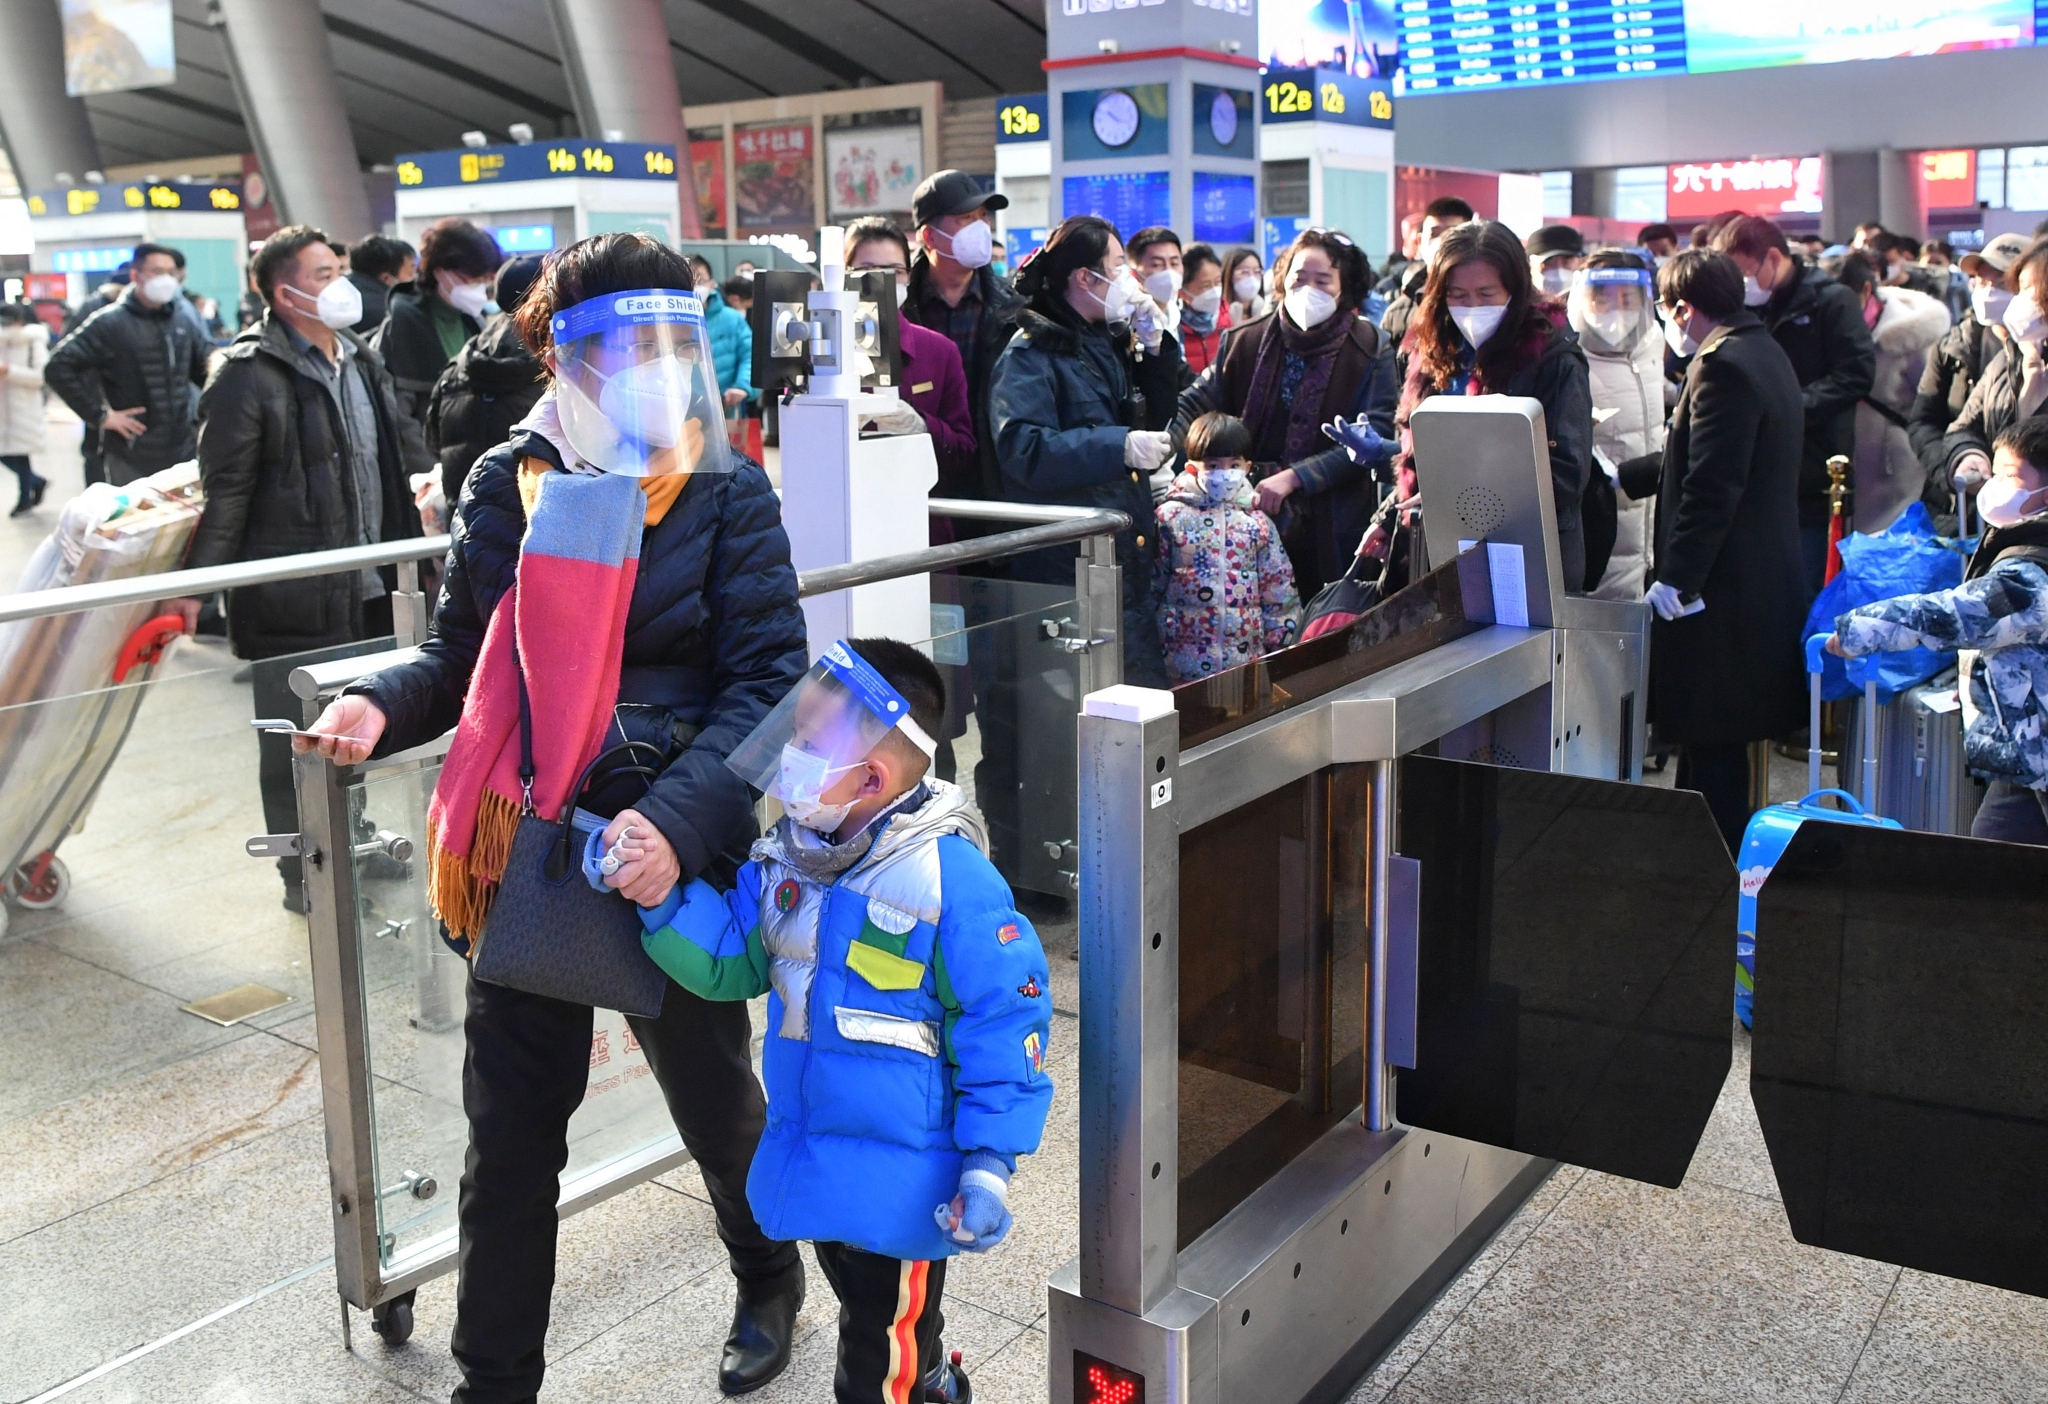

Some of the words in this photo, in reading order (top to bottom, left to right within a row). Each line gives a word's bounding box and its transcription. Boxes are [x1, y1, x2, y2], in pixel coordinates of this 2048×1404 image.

[1265, 82, 1312, 113] 12B
[1000, 105, 1040, 134] 13B
[582, 148, 613, 171] 14B
[626, 299, 662, 311] Face
[667, 298, 701, 312] Shield
[632, 315, 653, 323] Direct
[655, 314, 676, 322] Splash
[583, 1074, 621, 1101] lass
